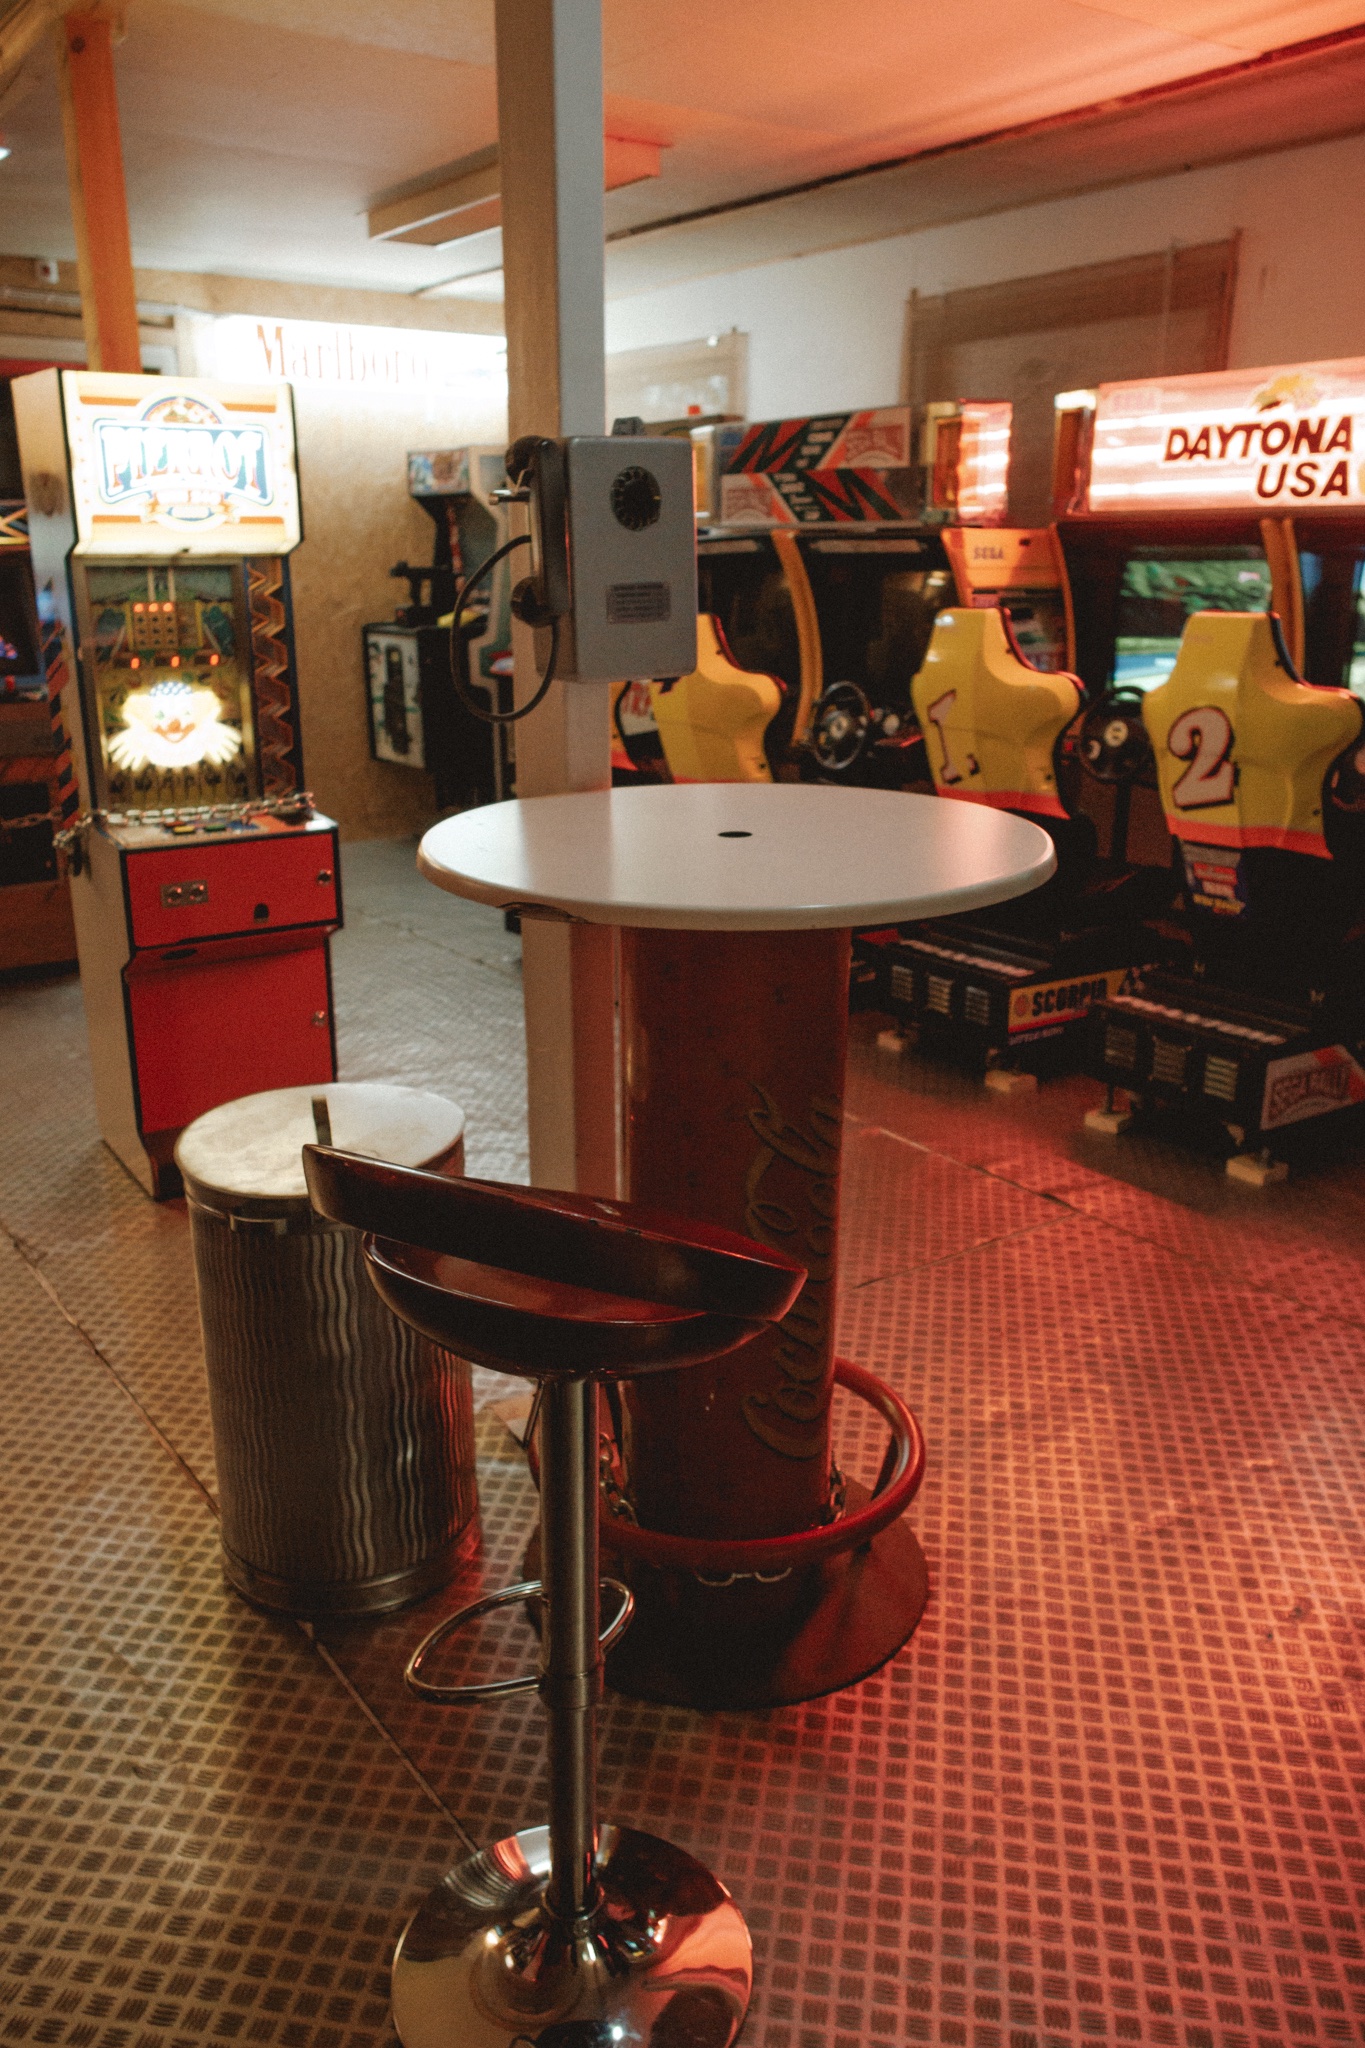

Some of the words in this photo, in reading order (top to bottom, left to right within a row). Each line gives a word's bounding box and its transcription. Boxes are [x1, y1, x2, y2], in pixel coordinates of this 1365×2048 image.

[256, 323, 430, 384] Marlboro
[1164, 415, 1353, 461] DAYTONA
[1256, 461, 1349, 498] USA
[1168, 706, 1239, 811] 2
